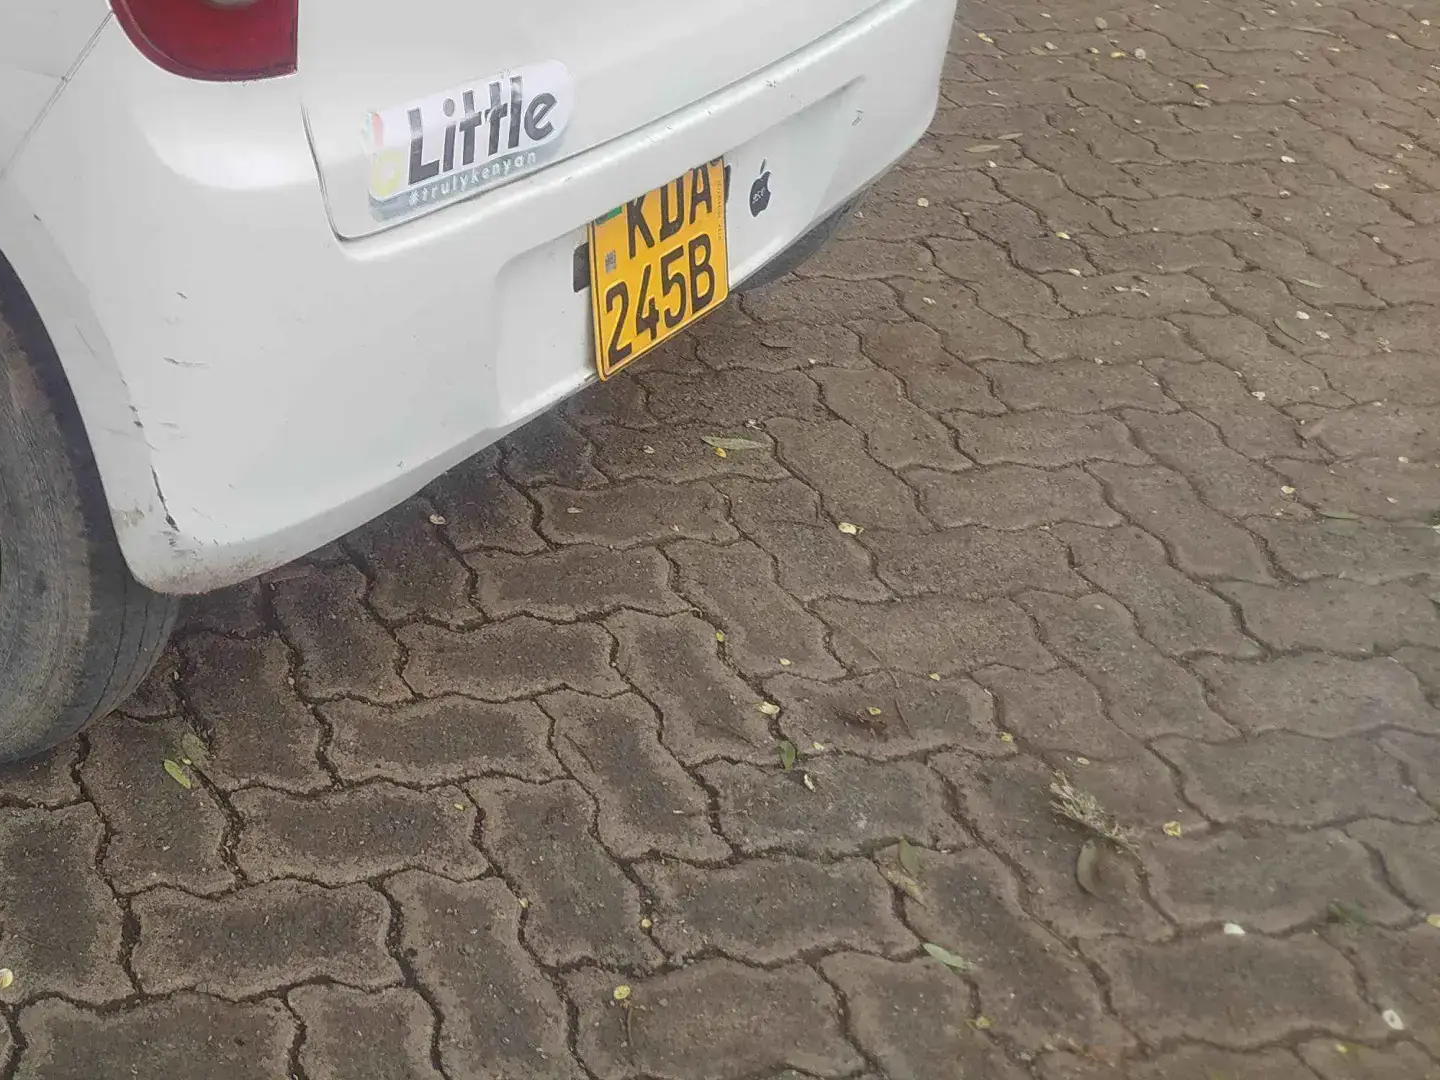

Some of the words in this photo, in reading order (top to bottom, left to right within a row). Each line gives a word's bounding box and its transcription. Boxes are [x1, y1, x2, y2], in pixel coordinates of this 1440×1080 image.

[407, 75, 558, 186] Little
[626, 163, 713, 259] KDA
[605, 233, 716, 367] 245B
